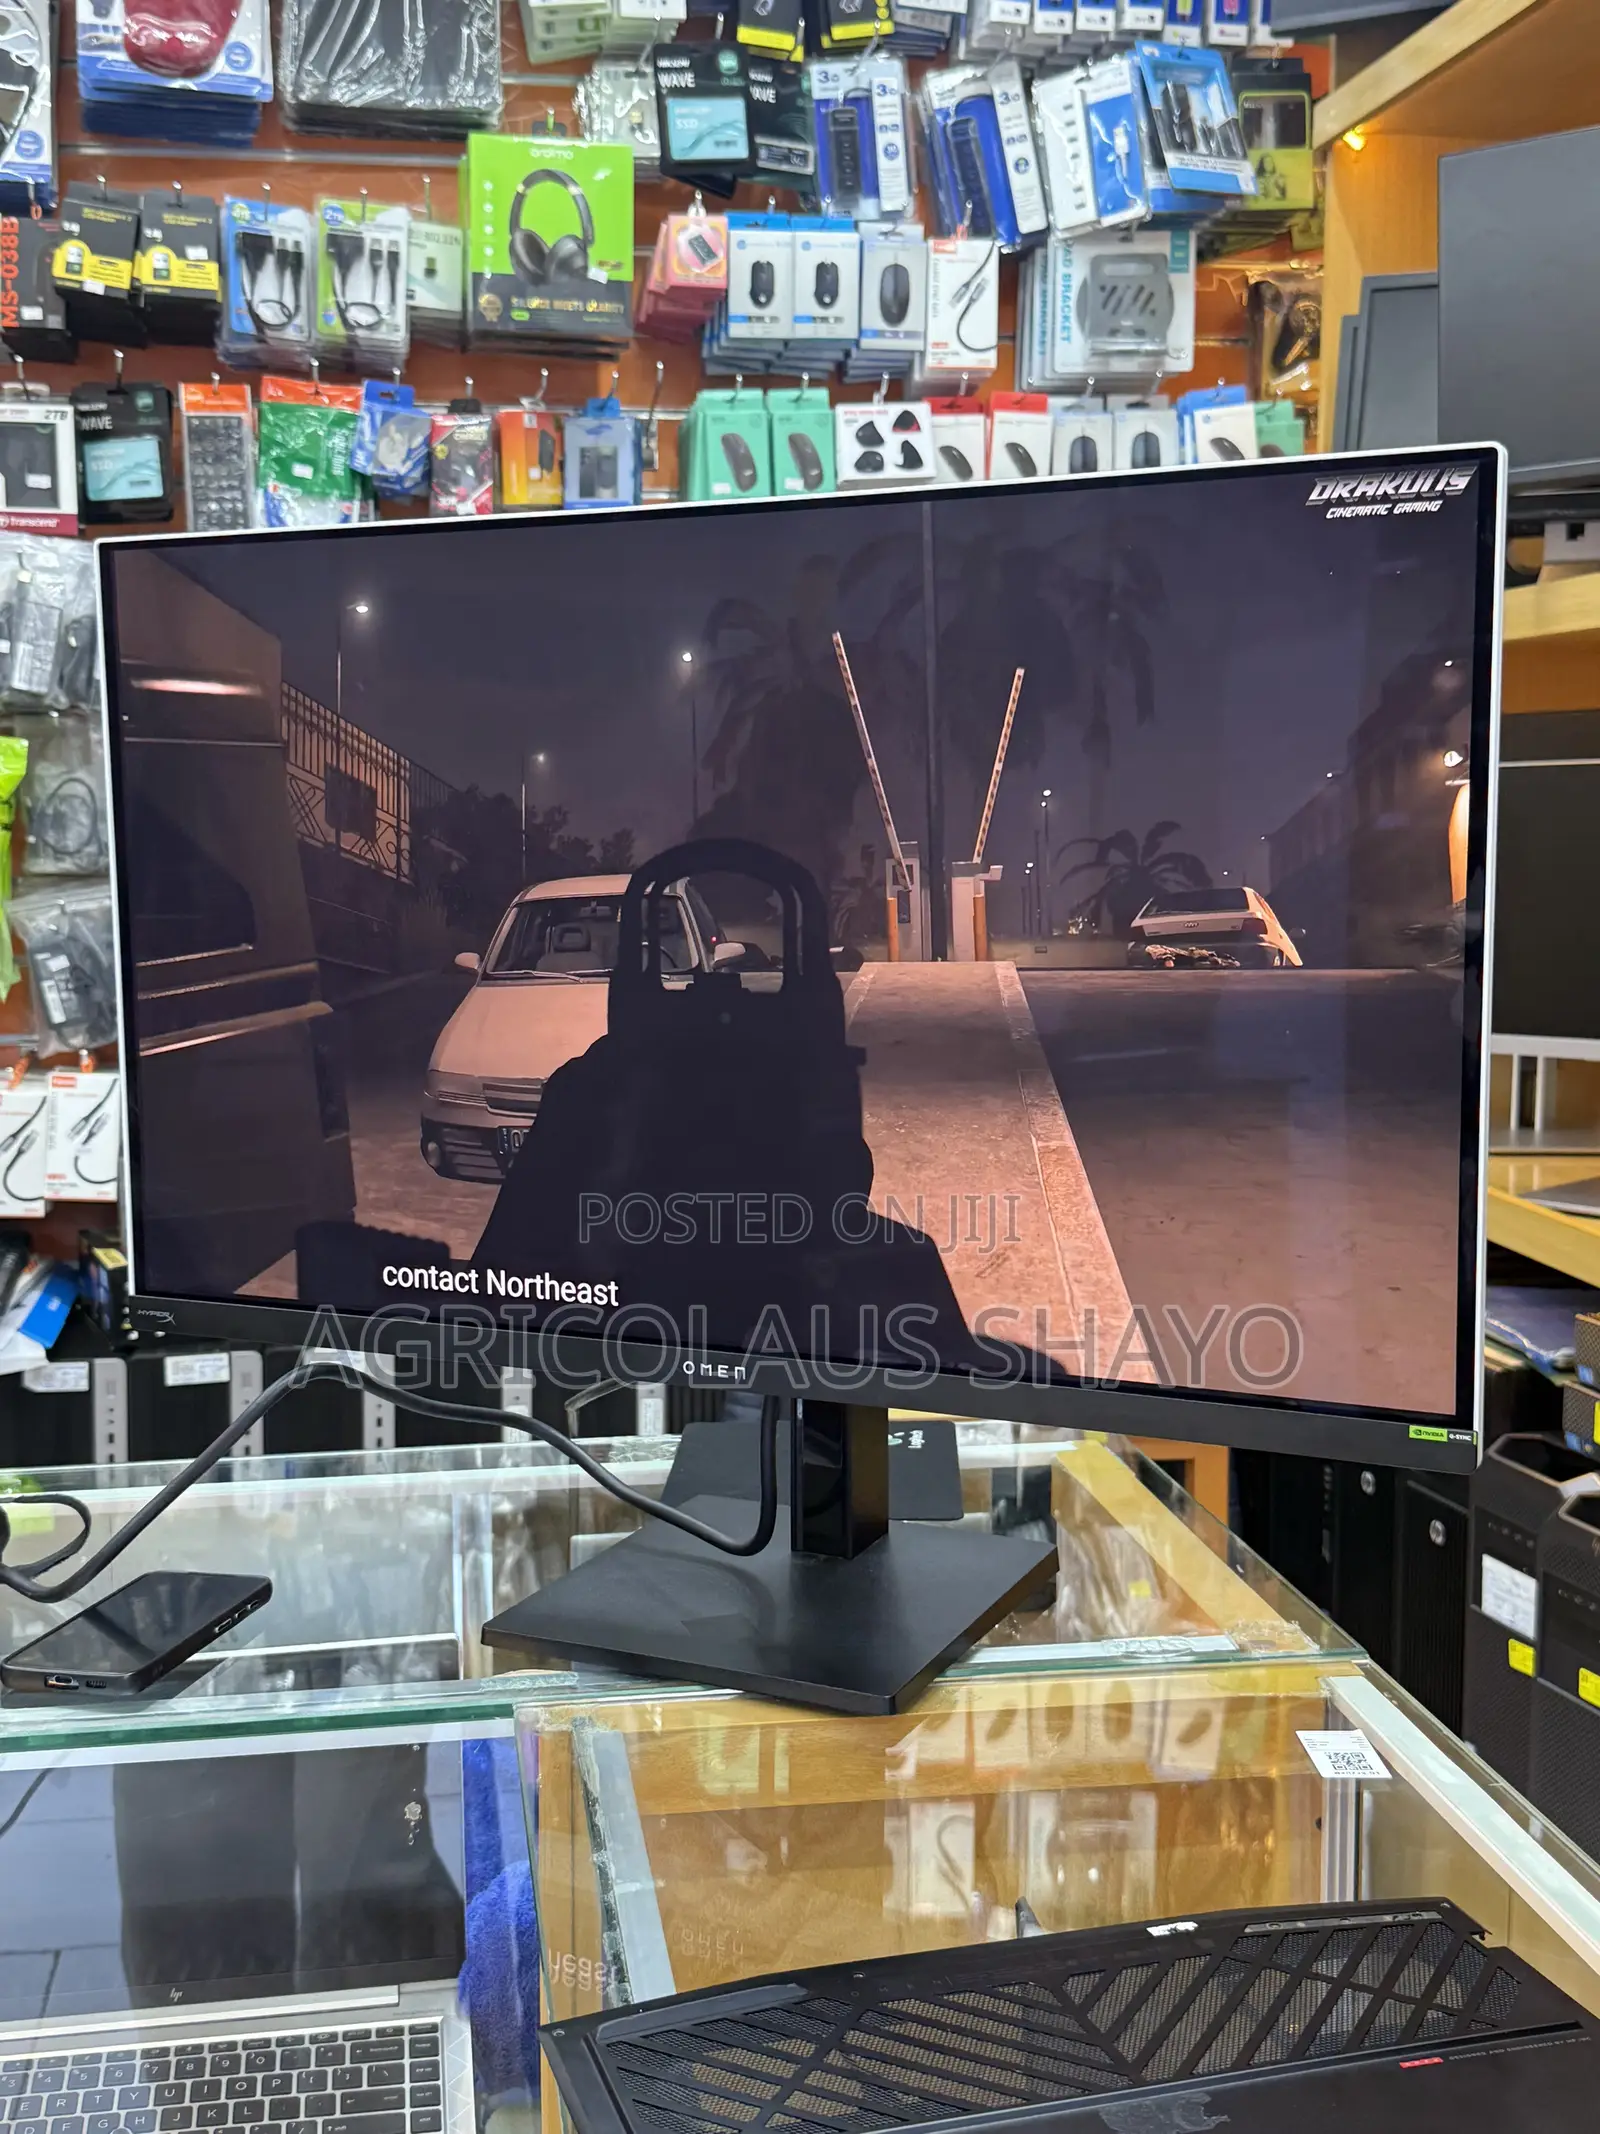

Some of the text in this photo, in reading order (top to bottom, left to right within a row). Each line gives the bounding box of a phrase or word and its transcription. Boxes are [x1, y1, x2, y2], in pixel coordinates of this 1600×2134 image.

[657, 72, 696, 88] WAVE
[0, 216, 20, 328] MS-038B
[44, 409, 69, 421] 2TB
[1326, 500, 1444, 519] CINEMATIC GAMING
[382, 1264, 619, 1307] contact Northeast
[682, 1360, 746, 1380] OMEN
[1448, 1433, 1473, 1441] G-SYNC
[115, 2069, 123, 2077] 6
[151, 2066, 159, 2074] 7
[272, 2078, 281, 2088] P
[129, 2092, 139, 2100] Y
[165, 2088, 175, 2097] U
[56, 2099, 67, 2107] R
[94, 2095, 103, 2104] T
[20, 2102, 30, 2111] E
[244, 2106, 252, 2115] L
[173, 2112, 181, 2121] J
[207, 2108, 217, 2118] K
[98, 2119, 108, 2128] G
[135, 2116, 145, 2125] H
[62, 2122, 72, 2131] F
